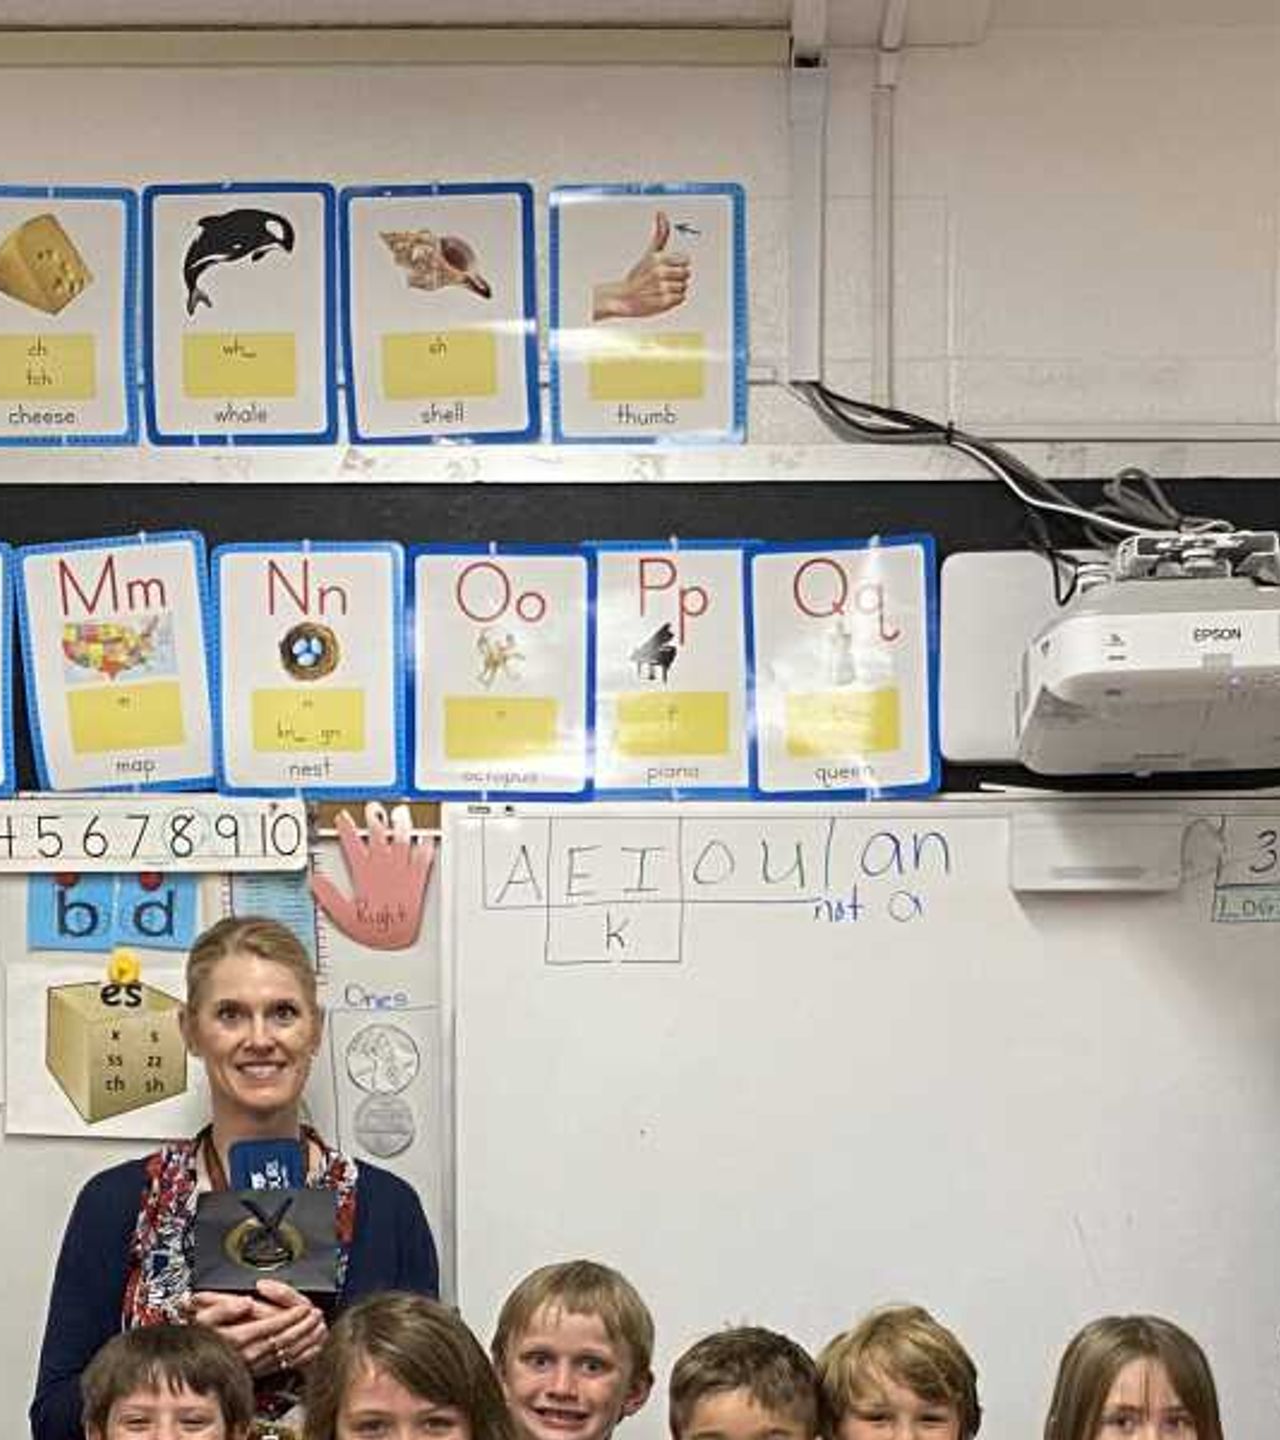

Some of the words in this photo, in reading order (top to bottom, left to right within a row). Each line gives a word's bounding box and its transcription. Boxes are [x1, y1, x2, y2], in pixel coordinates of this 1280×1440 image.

[27, 341, 50, 359] ch
[25, 368, 54, 388] tch
[7, 404, 76, 426] cheese
[213, 403, 269, 425] whale
[421, 403, 465, 425] shell
[616, 403, 678, 425] thumb
[57, 554, 166, 616] Mm
[266, 558, 348, 616] Nn
[455, 561, 547, 622] Oo
[638, 557, 708, 647] Pp
[793, 558, 901, 642] Qq
[1192, 628, 1243, 641] EPSON
[115, 756, 156, 780] map
[288, 758, 333, 778] nest
[36, 816, 65, 858] 5
[83, 816, 109, 858] 6
[125, 815, 151, 857] 7
[170, 815, 198, 857] 8
[216, 814, 239, 856] 9
[260, 813, 302, 857] 10
[494, 843, 543, 903] A
[564, 844, 603, 897] E
[860, 830, 953, 877] an
[57, 889, 99, 938] b
[133, 889, 175, 938] d
[356, 902, 407, 933] Right
[100, 981, 143, 1008] es
